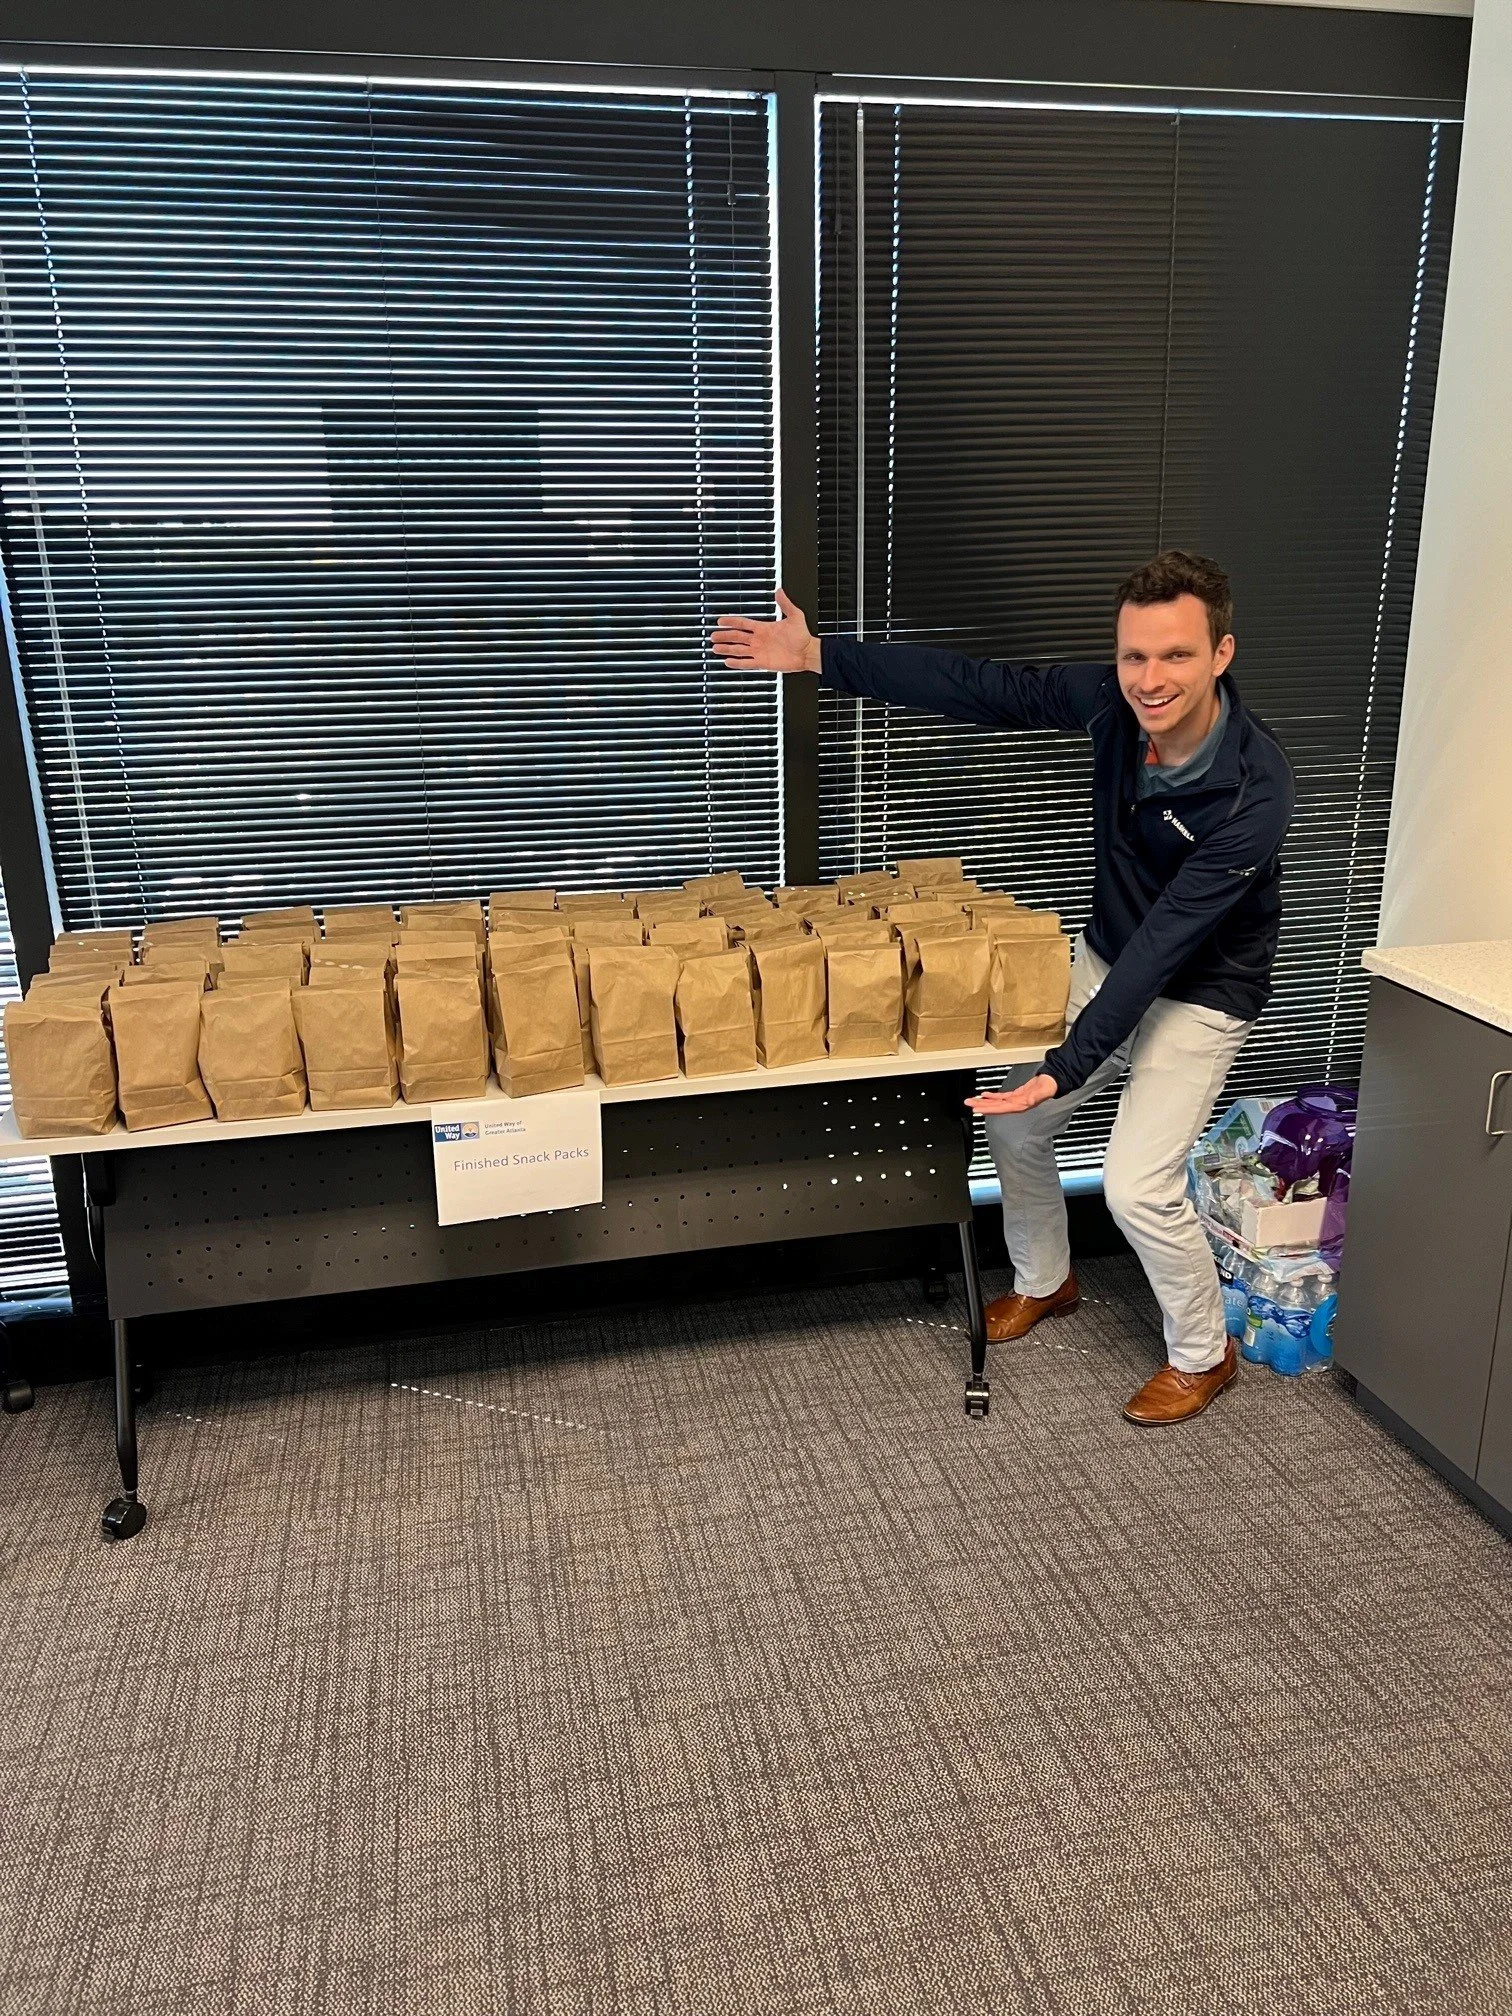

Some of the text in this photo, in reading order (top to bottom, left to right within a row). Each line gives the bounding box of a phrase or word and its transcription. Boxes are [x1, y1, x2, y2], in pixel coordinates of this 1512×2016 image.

[434, 1124, 460, 1133] United
[445, 1132, 461, 1141] Way
[454, 1147, 589, 1171] Finished Snack Packs
